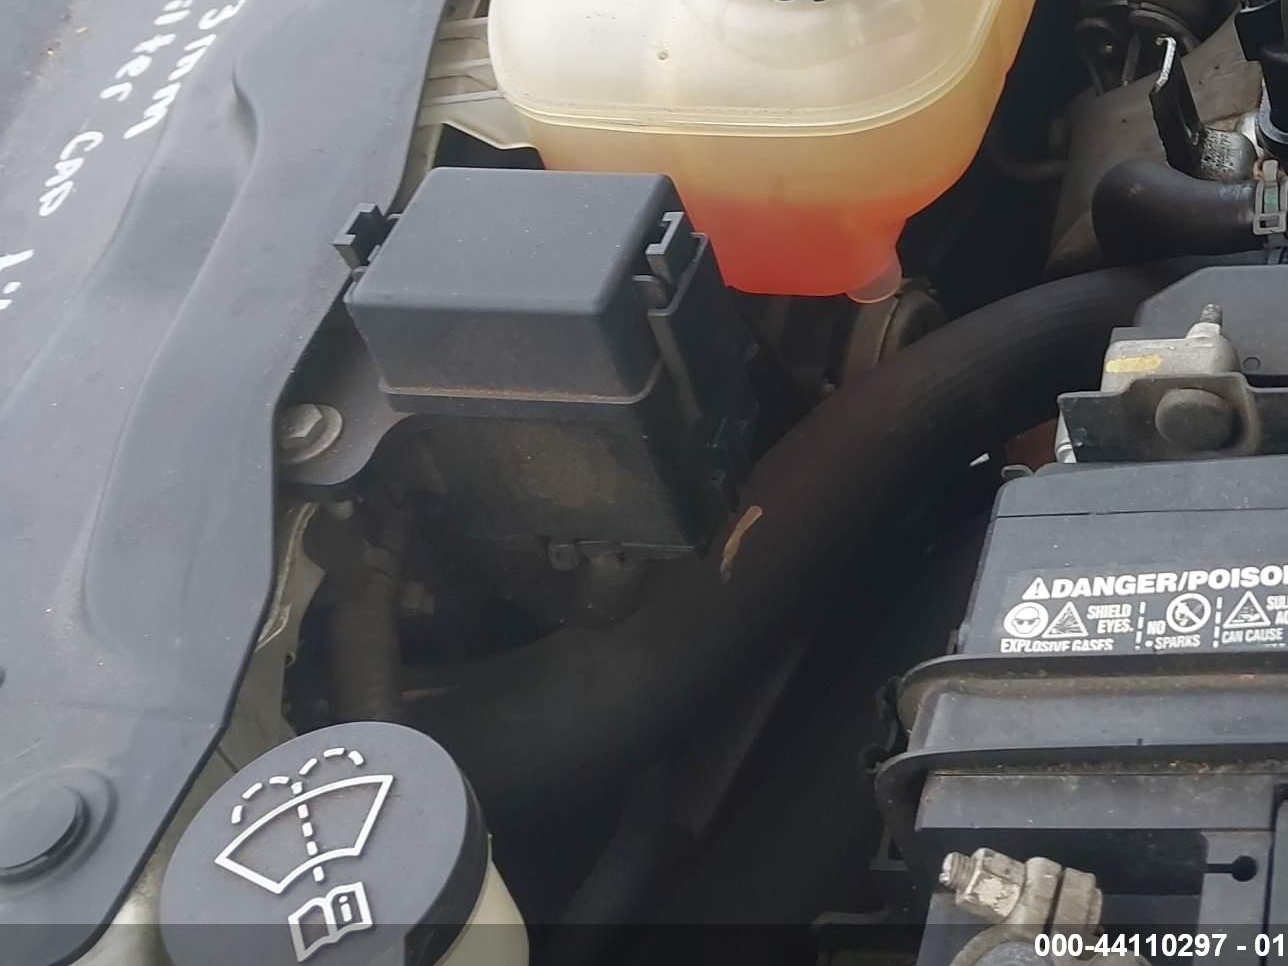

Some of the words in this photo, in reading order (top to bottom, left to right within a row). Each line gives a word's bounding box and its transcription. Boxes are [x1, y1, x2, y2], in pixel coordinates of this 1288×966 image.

[1086, 602, 1133, 622] SHIELD
[1096, 618, 1135, 634] EYES.
[1146, 620, 1166, 635] NO
[1221, 630, 1244, 645] CAN
[1245, 627, 1285, 643] CAUSE
